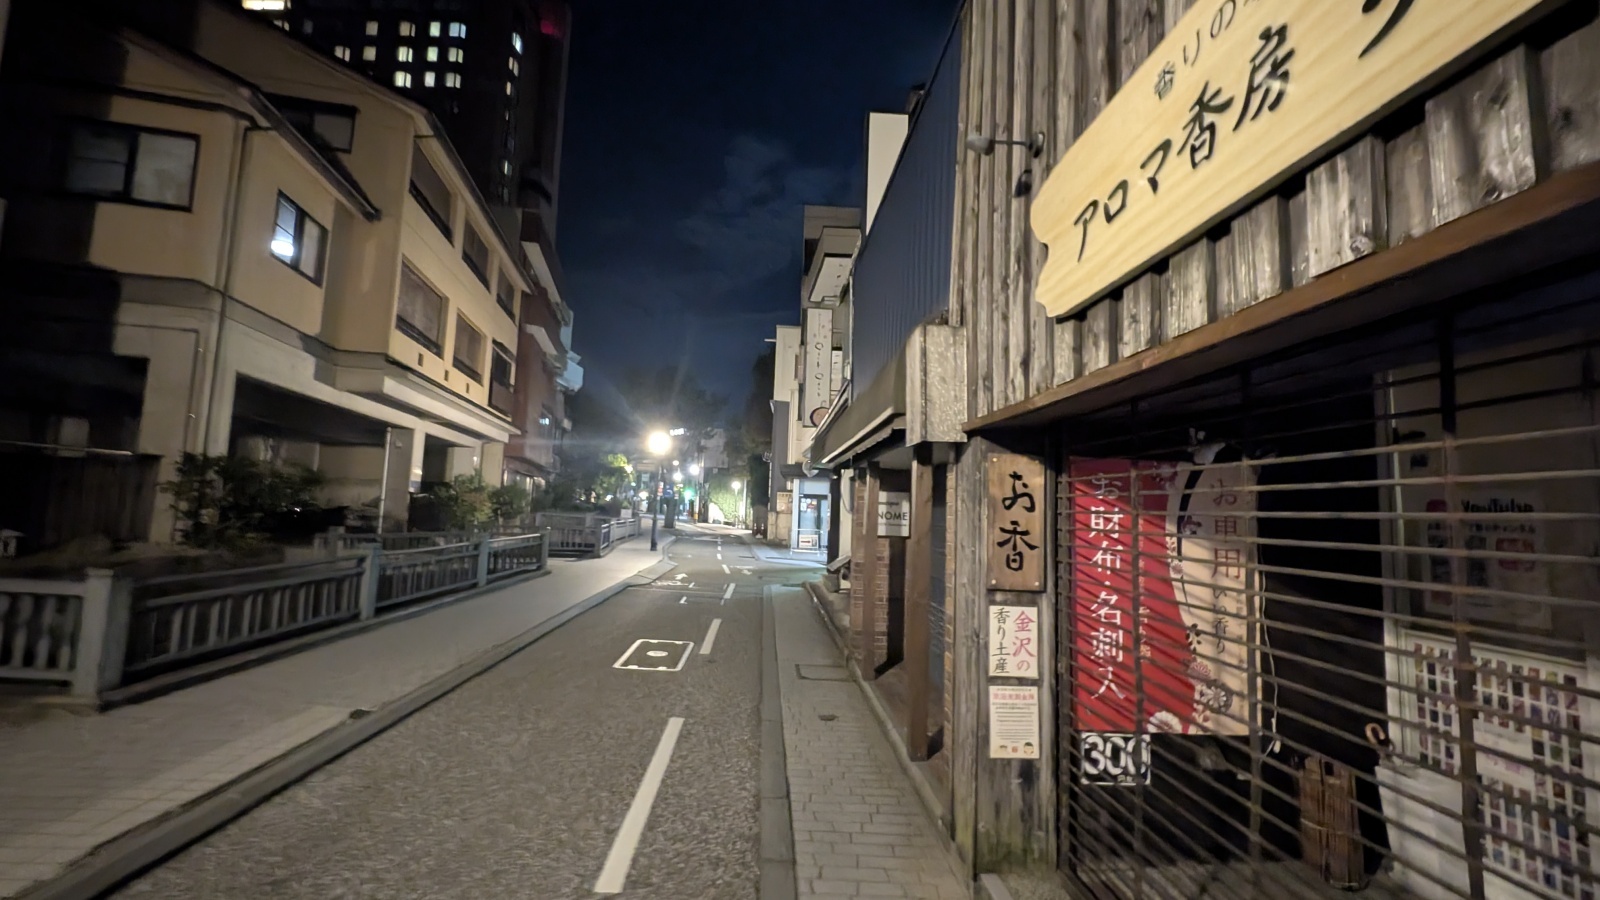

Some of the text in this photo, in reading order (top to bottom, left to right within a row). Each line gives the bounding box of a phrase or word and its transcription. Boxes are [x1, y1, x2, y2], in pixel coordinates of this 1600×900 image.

[1154, 0, 1258, 100] 香りの
[1073, 22, 1296, 264] アロマ香房
[996, 470, 1040, 572] お香
[991, 607, 1011, 675] 香り土産
[1012, 610, 1037, 672] 金沢の
